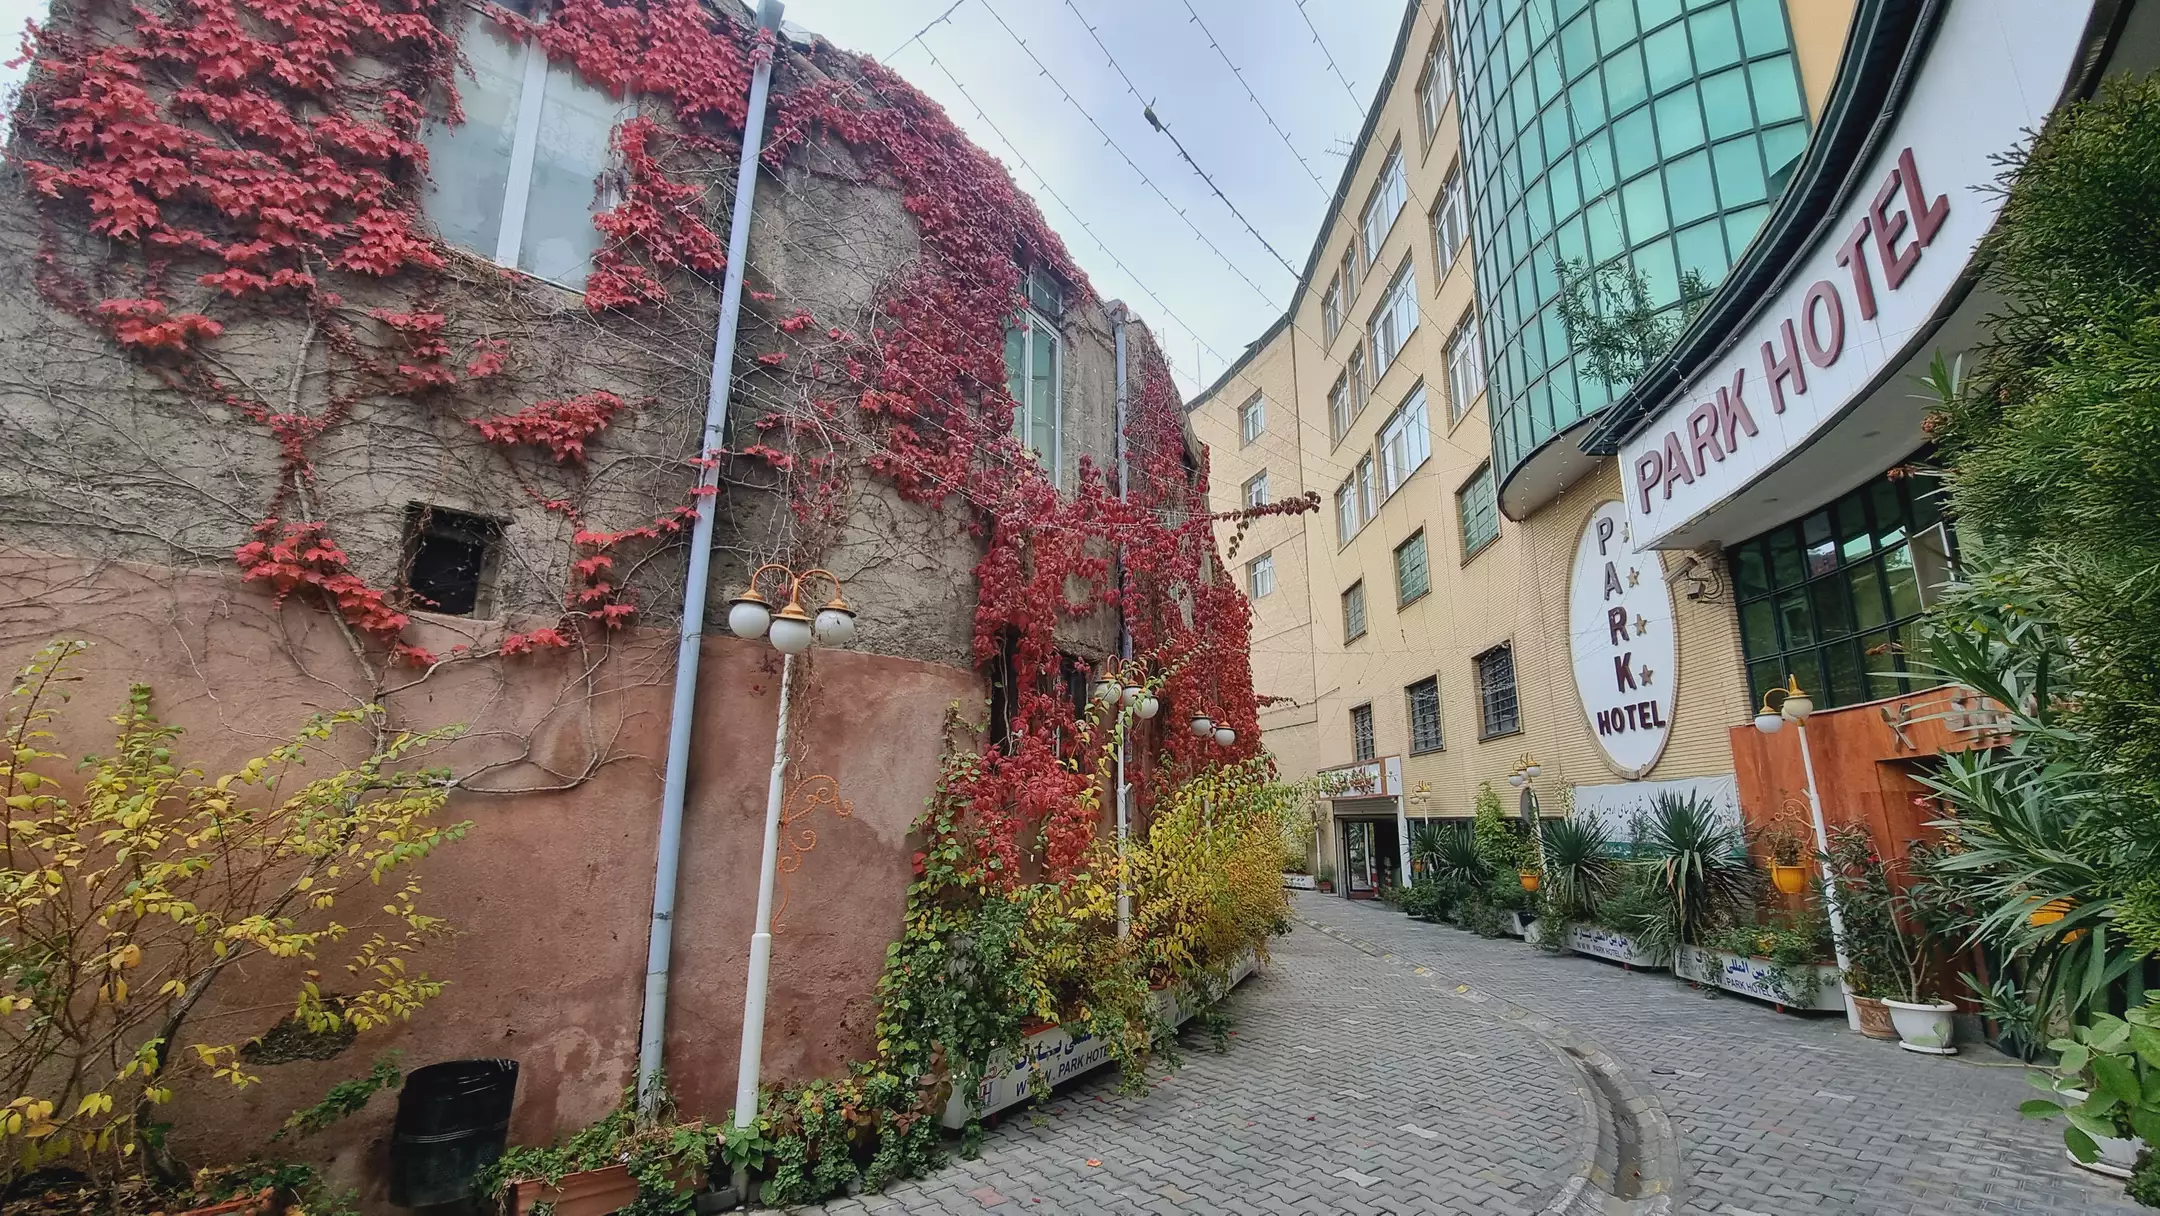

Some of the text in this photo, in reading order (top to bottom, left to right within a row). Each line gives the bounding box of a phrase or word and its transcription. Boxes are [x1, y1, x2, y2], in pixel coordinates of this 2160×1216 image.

[1635, 147, 1950, 515] PARK HOTEL
[1595, 516, 1638, 694] PARK
[1597, 700, 1666, 736] HOTEL
[1726, 959, 1749, 974] المللی
[1747, 983, 1772, 998] HOTEL
[1058, 1055, 1084, 1078] PARK
[1085, 1044, 1110, 1065] HOTE
